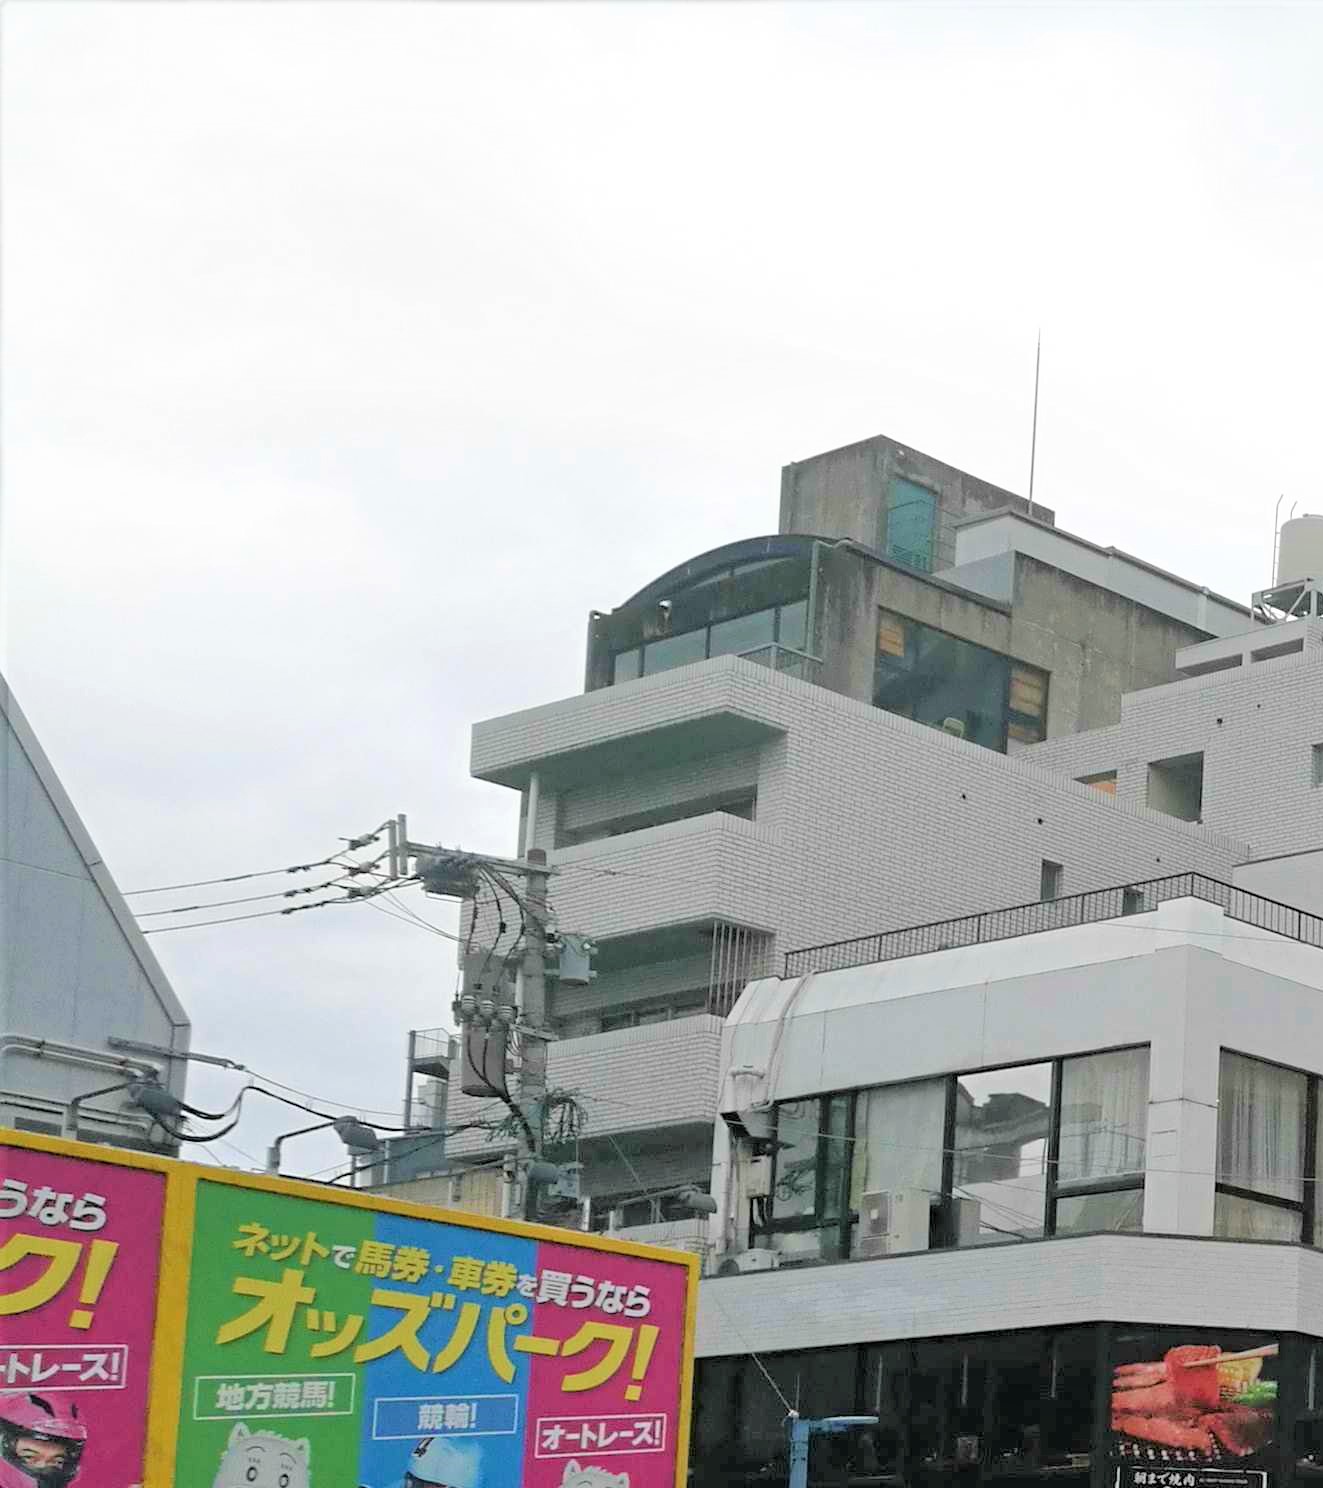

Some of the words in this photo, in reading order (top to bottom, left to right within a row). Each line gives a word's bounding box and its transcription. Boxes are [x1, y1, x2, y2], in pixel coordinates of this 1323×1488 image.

[216, 1268, 660, 1401] オッズパーク!
[216, 1381, 335, 1410] 地方競馬!
[417, 1402, 476, 1430] 競輪!
[542, 1418, 661, 1452] オートレース!
